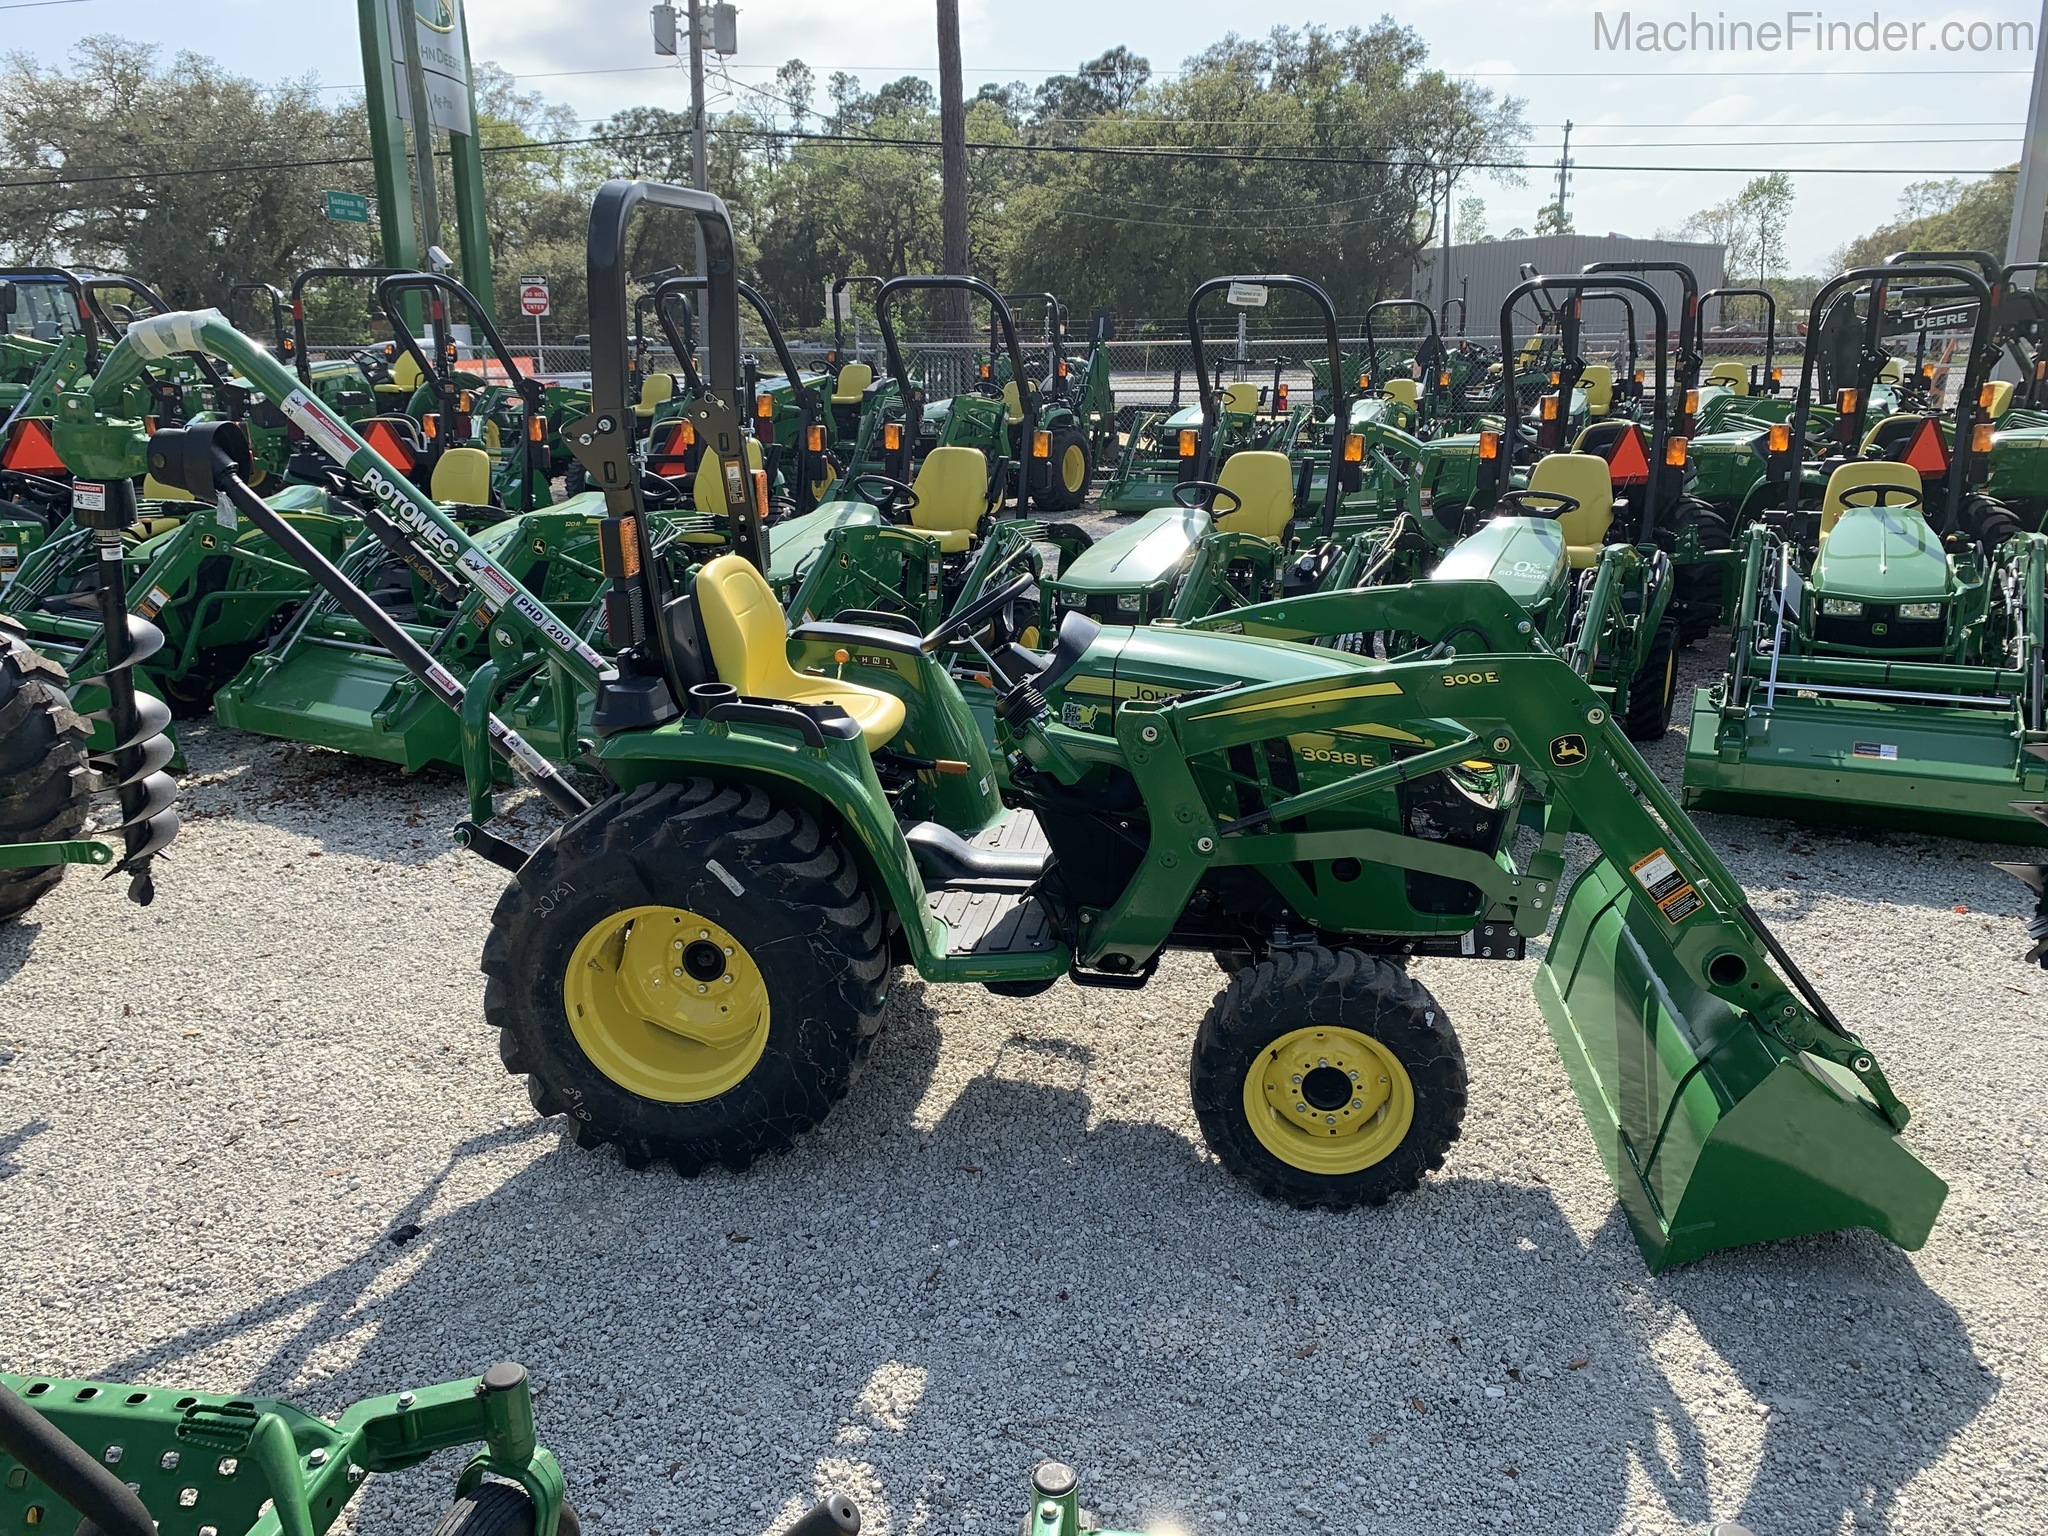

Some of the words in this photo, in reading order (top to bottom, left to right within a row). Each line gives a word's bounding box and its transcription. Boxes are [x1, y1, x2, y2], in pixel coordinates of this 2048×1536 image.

[437, 47, 462, 72] DEERE
[1914, 312, 1968, 330] DEERE
[321, 416, 344, 437] DANGER
[78, 484, 101, 492] DANGER
[362, 467, 459, 558] ROTOMEC
[491, 570, 513, 592] DANGER
[517, 597, 545, 623] PHD
[546, 624, 571, 646] 200
[1130, 685, 1172, 702] JOH
[1064, 713, 1081, 722] Pro
[1669, 888, 1690, 904] WARNING
